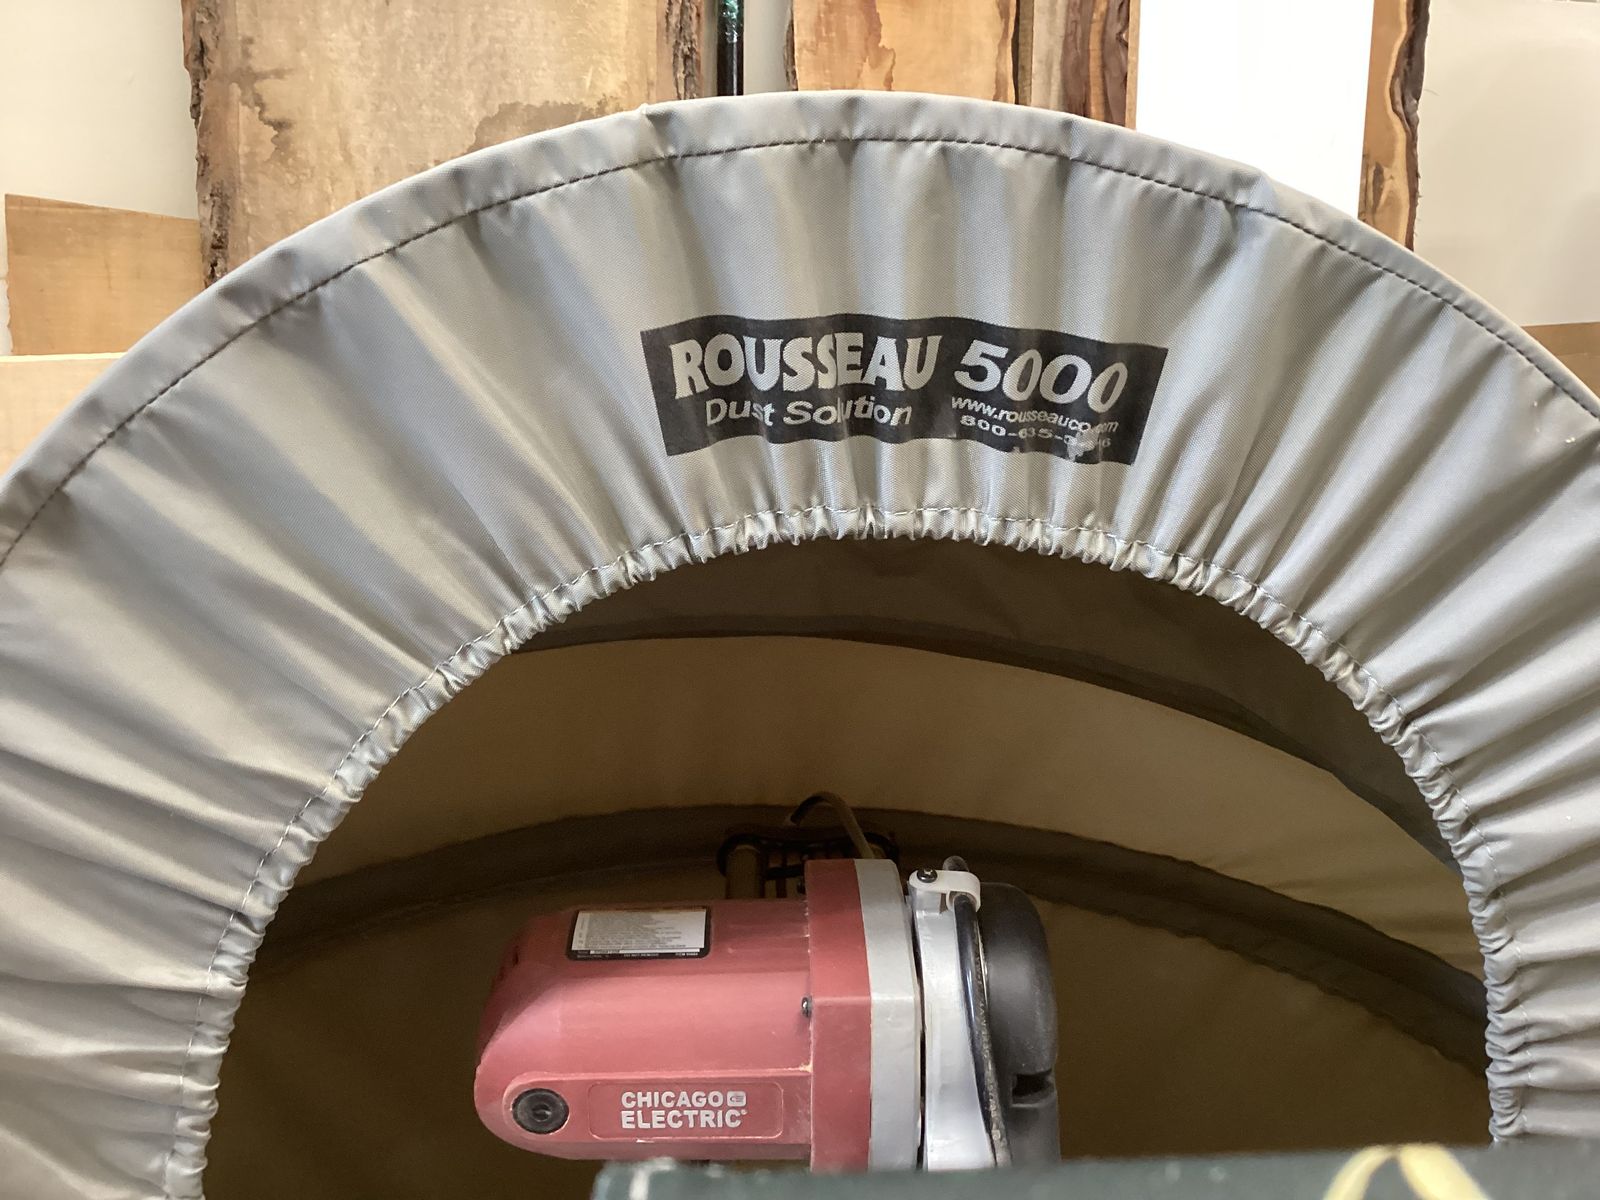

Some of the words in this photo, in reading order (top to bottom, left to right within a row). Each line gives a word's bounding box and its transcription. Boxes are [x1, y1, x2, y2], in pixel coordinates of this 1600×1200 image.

[669, 332, 943, 399] ROUSSEAU
[953, 339, 1129, 413] 5000
[705, 398, 775, 427] Dust
[783, 396, 913, 427] Solution
[951, 396, 1119, 433] www.rousseaucocom
[621, 1091, 724, 1108] CHICAGO
